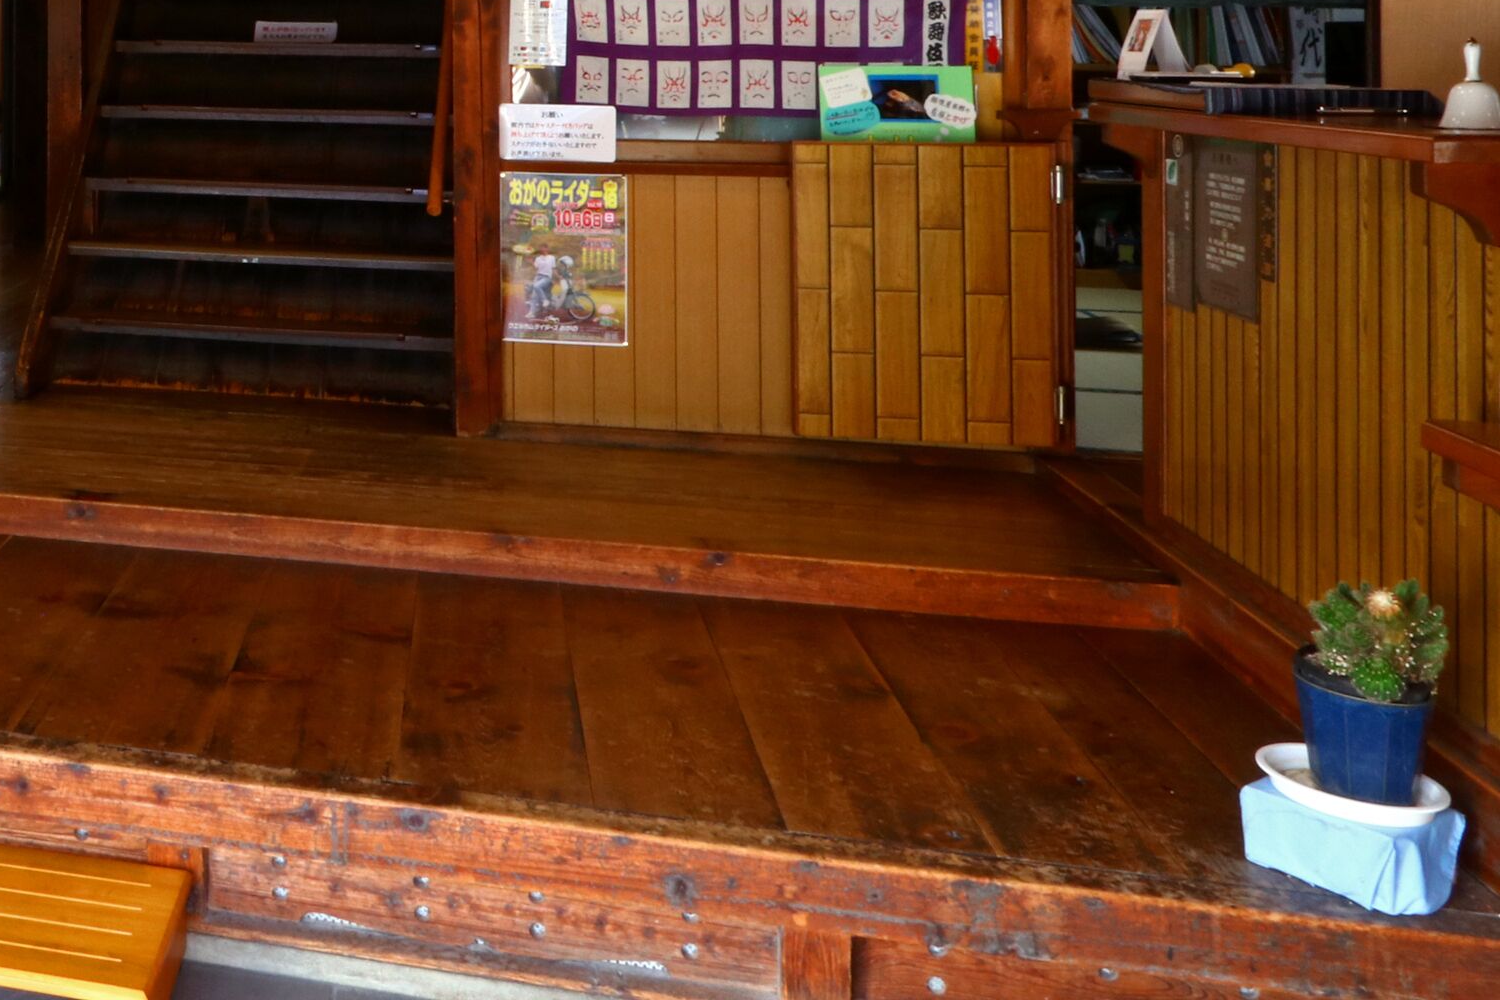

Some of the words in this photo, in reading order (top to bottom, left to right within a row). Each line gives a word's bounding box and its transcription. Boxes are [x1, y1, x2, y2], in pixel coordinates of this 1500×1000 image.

[926, 0, 947, 66] 歌舞伎
[509, 178, 618, 209] おがのライダー宿
[553, 209, 603, 228] 10月6日
